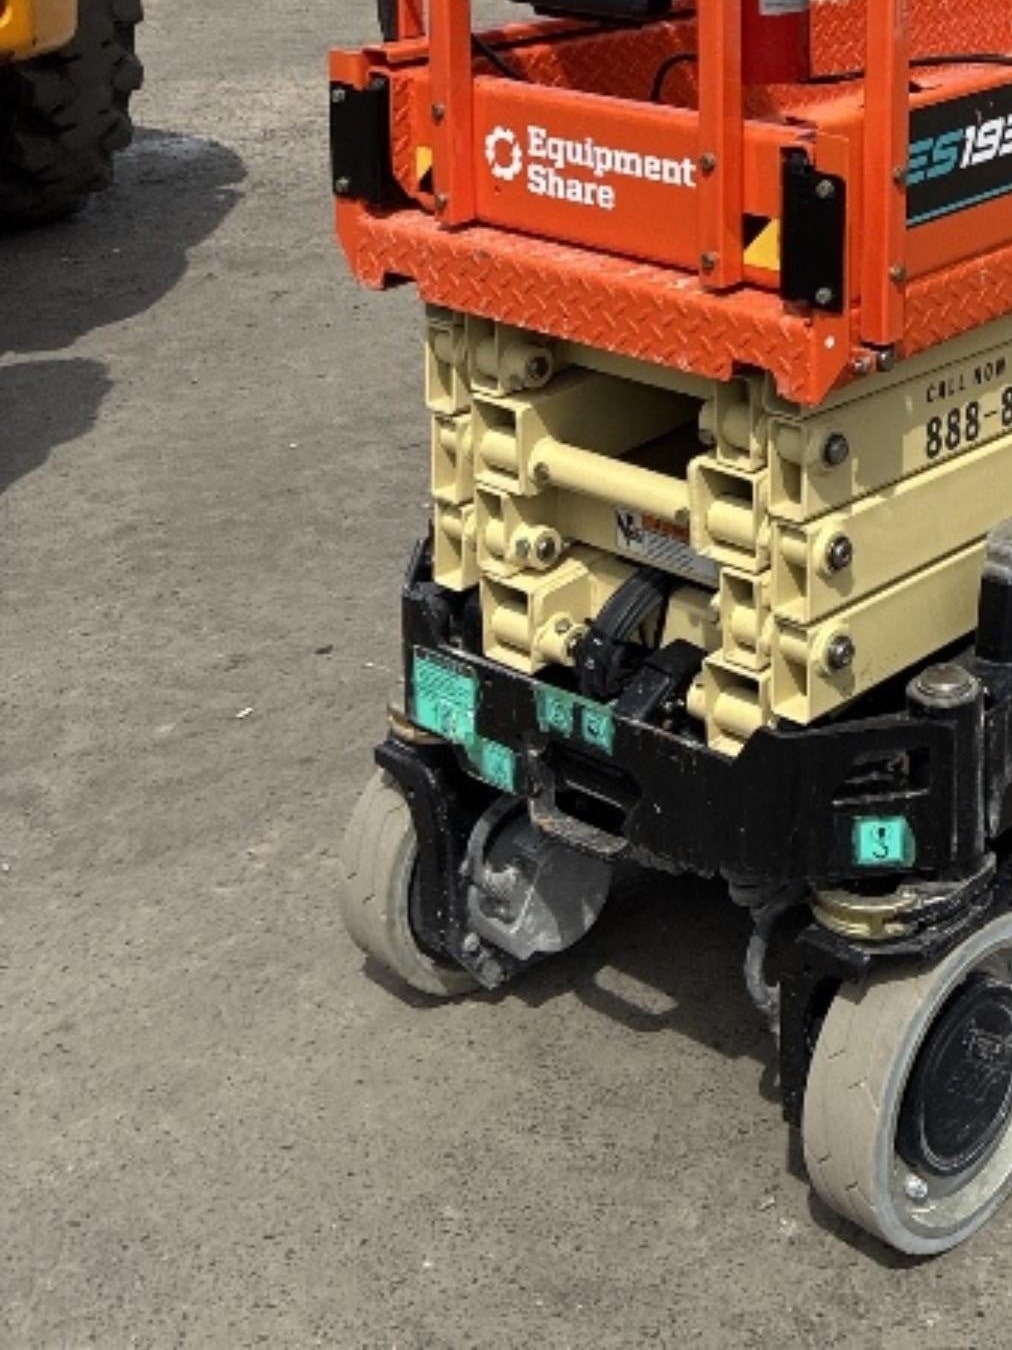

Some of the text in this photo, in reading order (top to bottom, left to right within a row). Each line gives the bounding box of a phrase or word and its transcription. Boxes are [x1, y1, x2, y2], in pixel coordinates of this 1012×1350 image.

[526, 124, 698, 188] Equipment
[526, 166, 615, 211] Share
[926, 356, 1007, 403] CALL NOW
